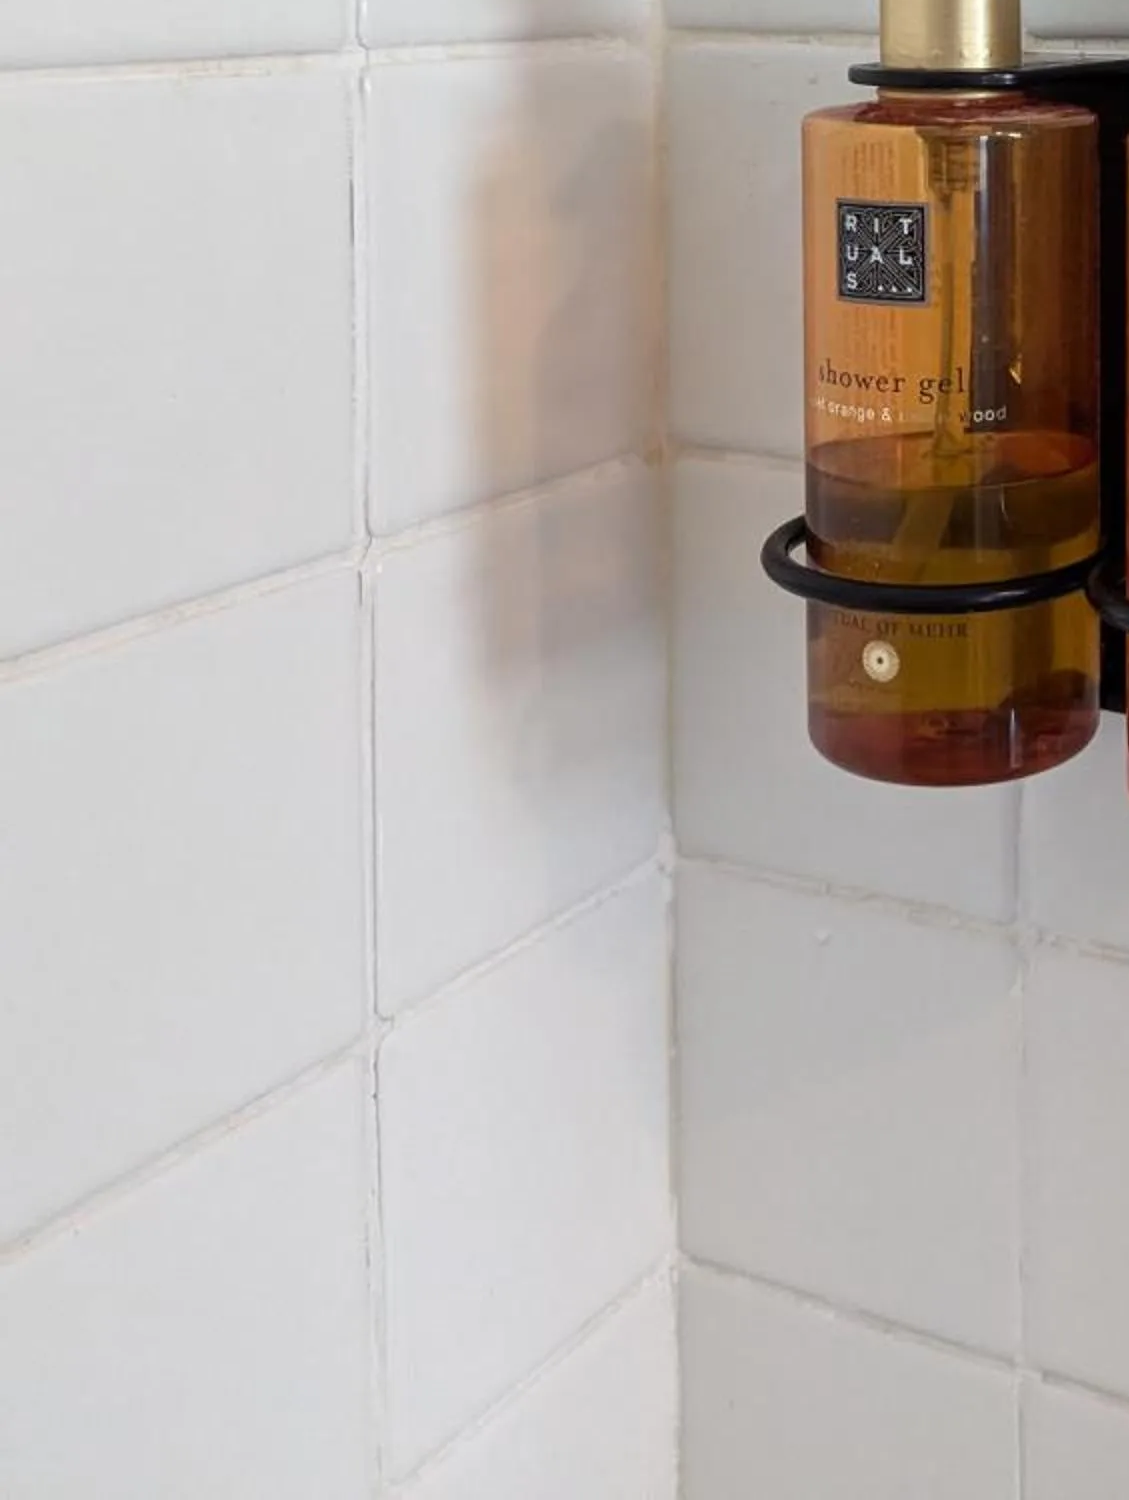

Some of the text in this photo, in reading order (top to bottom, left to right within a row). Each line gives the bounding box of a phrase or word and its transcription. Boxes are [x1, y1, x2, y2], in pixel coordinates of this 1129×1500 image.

[819, 357, 965, 404] shower gel
[881, 406, 892, 422] &
